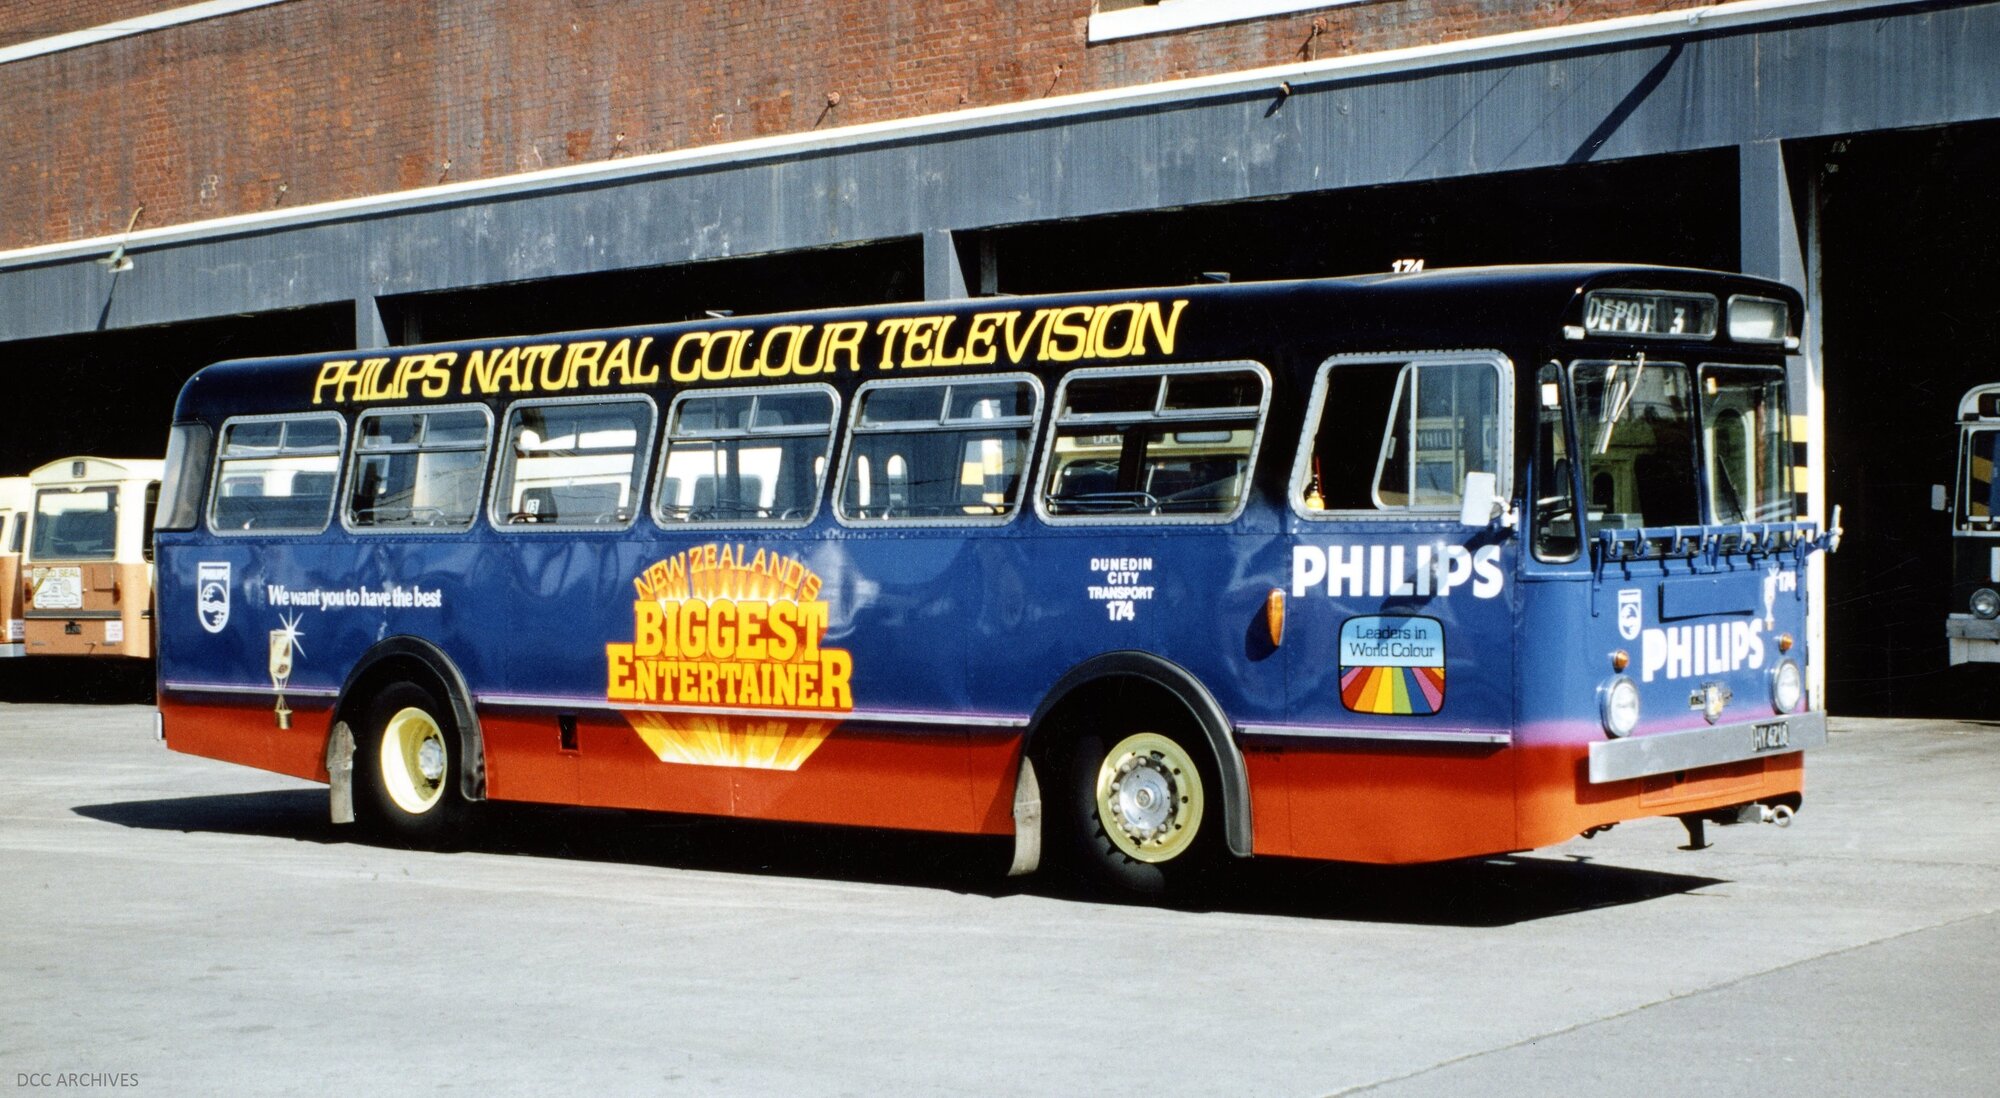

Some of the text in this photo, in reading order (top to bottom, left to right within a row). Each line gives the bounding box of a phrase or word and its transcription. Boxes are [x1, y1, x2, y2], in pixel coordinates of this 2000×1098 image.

[1392, 259, 1424, 273] 174
[1585, 297, 1685, 334] DEPOT 3
[313, 300, 1188, 403] PHILIPS NATURAL COLOUR TELEVISION
[633, 543, 822, 602] NEW ZEALAND'S
[1090, 558, 1152, 571] DUNEDIN
[1292, 545, 1504, 599] PHILIPS
[1107, 571, 1139, 584] CITY
[1777, 571, 1796, 592] 174
[267, 584, 442, 611] We want you to have the best
[1087, 586, 1155, 599] TRANSPORT
[1106, 600, 1135, 621] 174
[634, 598, 829, 662] BIGGEST
[1356, 625, 1427, 640] Leaders in
[1350, 643, 1435, 658] World Colour
[1642, 618, 1765, 683] PHILIPS
[606, 643, 853, 709] ENTERTAINER
